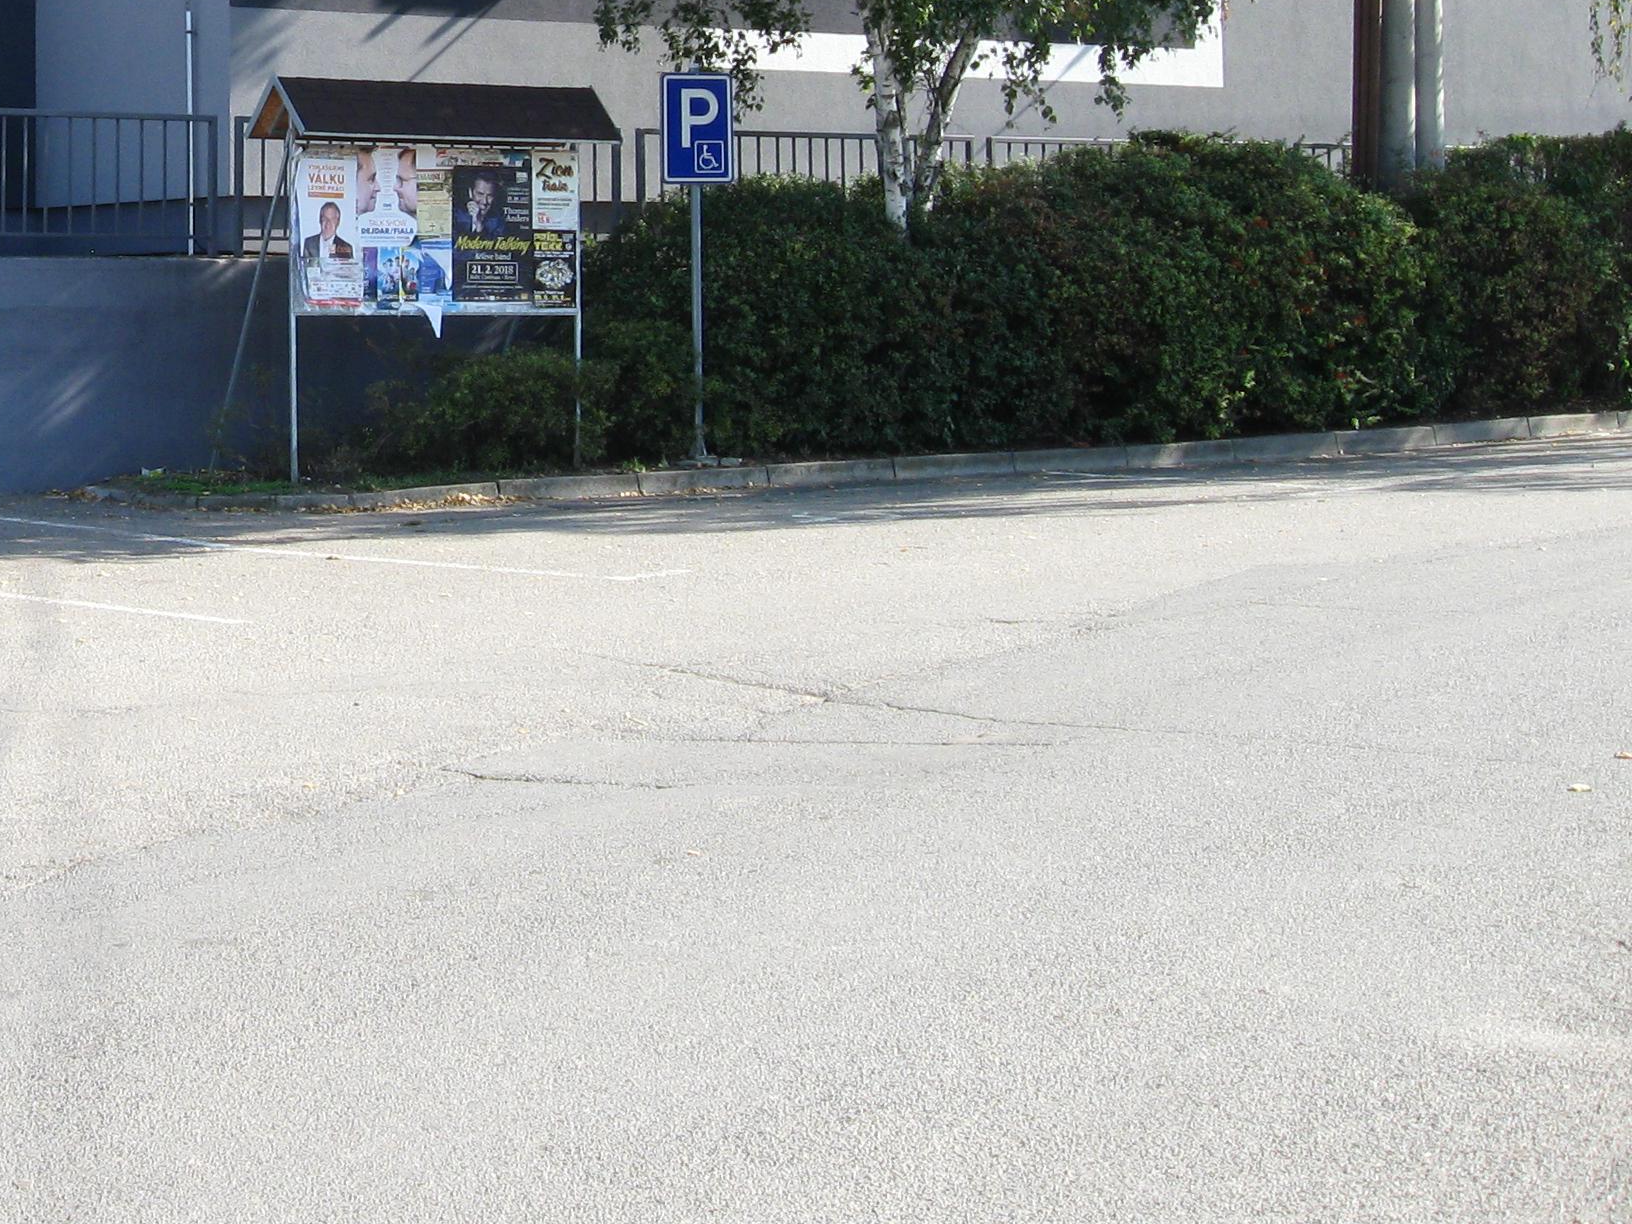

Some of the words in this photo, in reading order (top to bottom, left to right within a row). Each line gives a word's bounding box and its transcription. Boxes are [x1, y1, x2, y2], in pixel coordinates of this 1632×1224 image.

[680, 88, 719, 148] P
[454, 235, 494, 250] Modern
[494, 235, 531, 255] Talking
[494, 265, 514, 275] 2018
